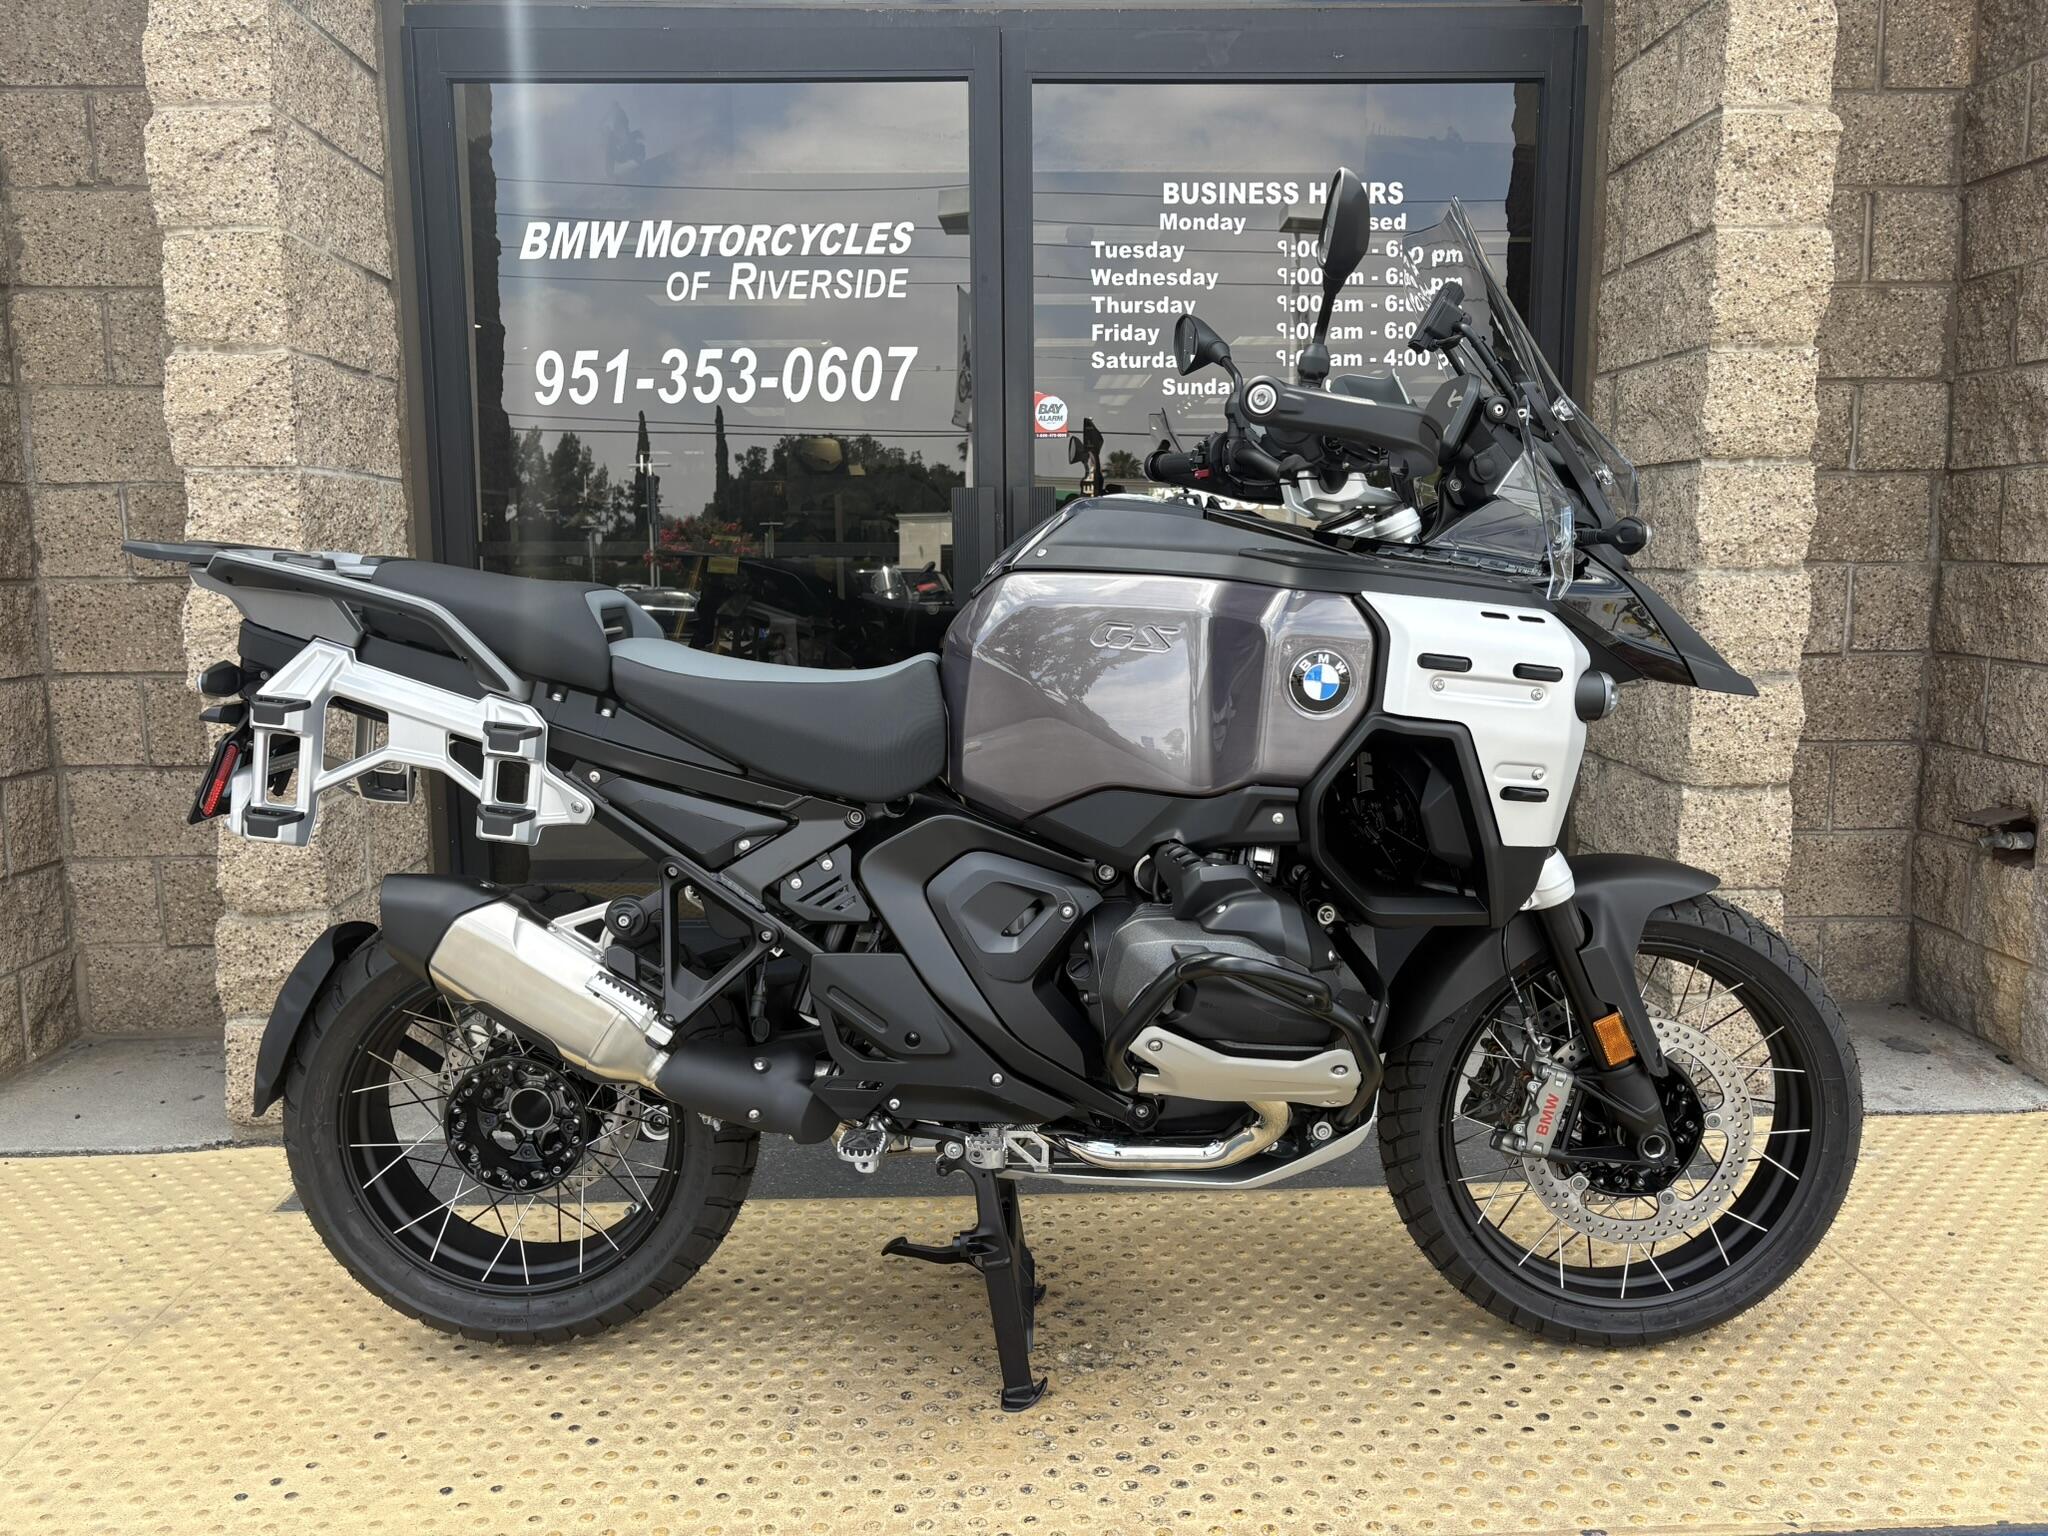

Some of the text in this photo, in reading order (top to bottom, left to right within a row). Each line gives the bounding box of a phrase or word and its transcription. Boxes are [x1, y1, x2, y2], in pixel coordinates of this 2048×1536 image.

[1163, 181, 1405, 205] BUSINESS HRS
[1159, 213, 1246, 235] Monday
[519, 219, 915, 260] BMW MOTORCYCLES
[1090, 240, 1185, 263] Tuesday
[1431, 248, 1464, 268] pm
[666, 262, 909, 302] OF RIVERSIDE
[1090, 268, 1219, 290] Wednesday
[1276, 267, 1324, 286] 9:00
[1091, 296, 1196, 315] Thursday
[1276, 294, 1323, 313] 9:00
[1331, 298, 1364, 313] am
[1091, 323, 1160, 346] Friday
[1329, 326, 1364, 341] am
[1091, 351, 1178, 369] Saturda
[1329, 353, 1364, 368] am
[1382, 348, 1431, 368] 4:00
[534, 346, 919, 406] 951-353-0607
[1161, 377, 1235, 397] Sunda
[1037, 403, 1064, 415] BAY
[1298, 653, 1347, 675] BMW
[1535, 1092, 1560, 1136] BMW
